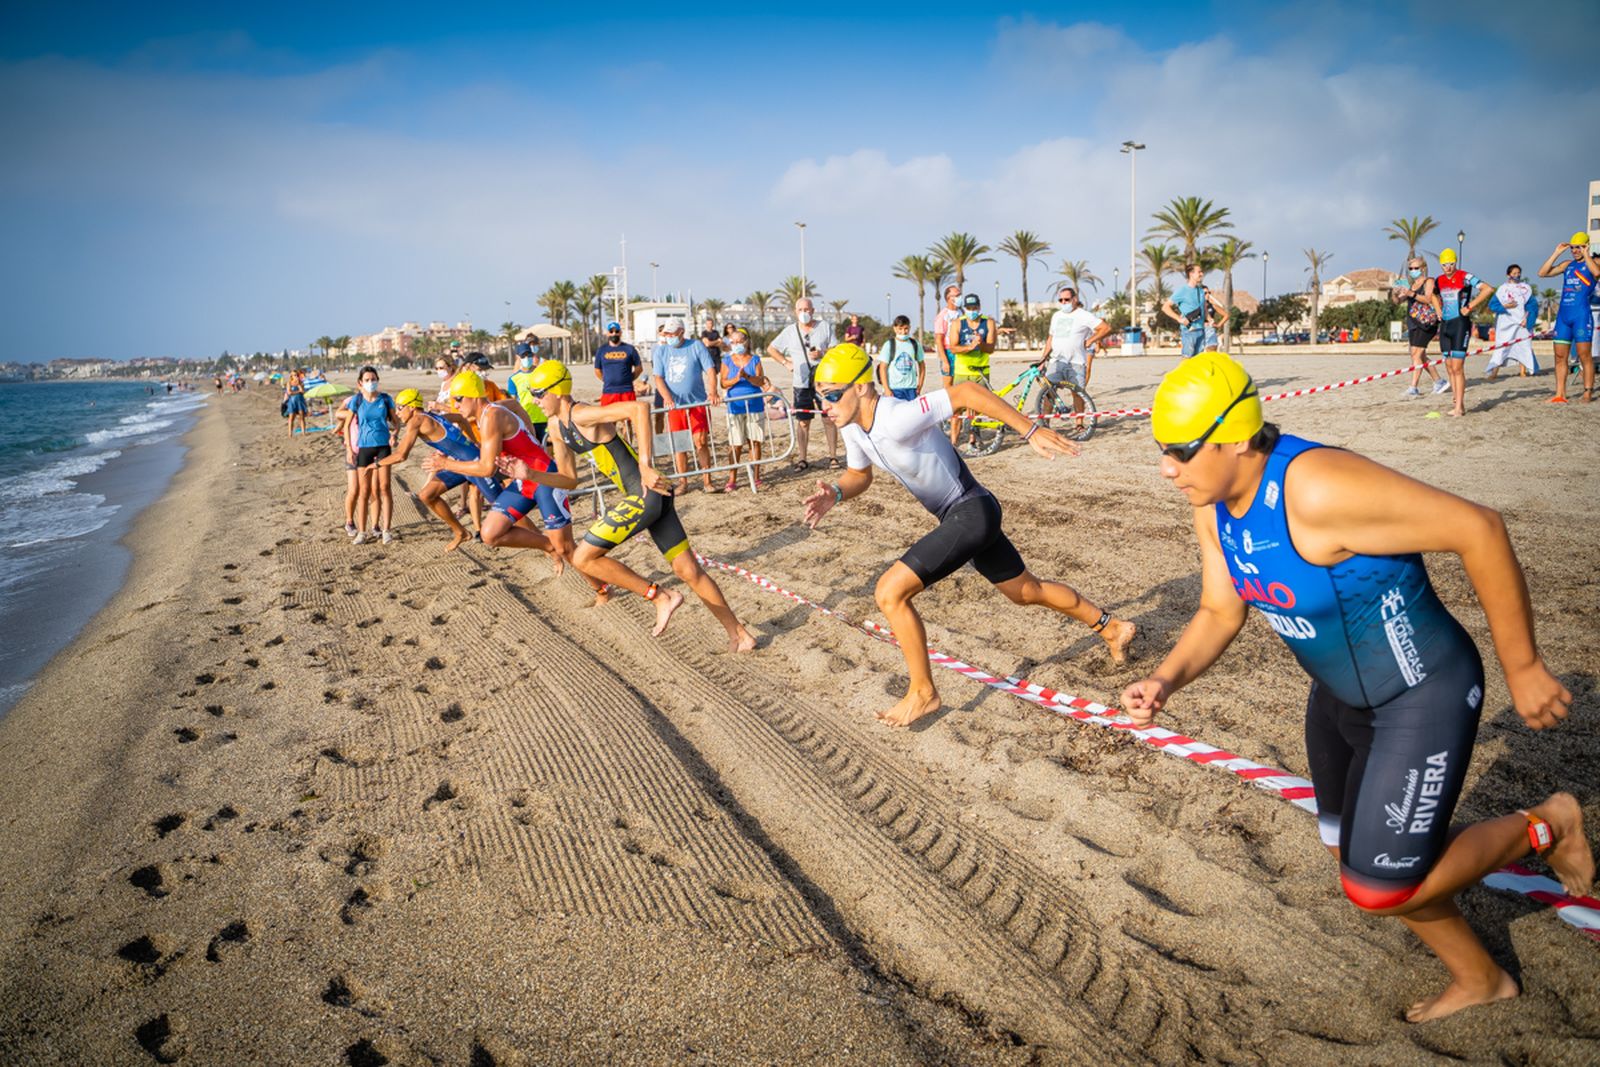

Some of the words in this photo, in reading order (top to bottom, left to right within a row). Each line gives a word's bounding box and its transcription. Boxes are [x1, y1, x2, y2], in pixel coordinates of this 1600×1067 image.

[1392, 616, 1427, 683] CONTRASA
[1385, 768, 1419, 835] Aluminios
[1409, 750, 1449, 834] RIVERA
